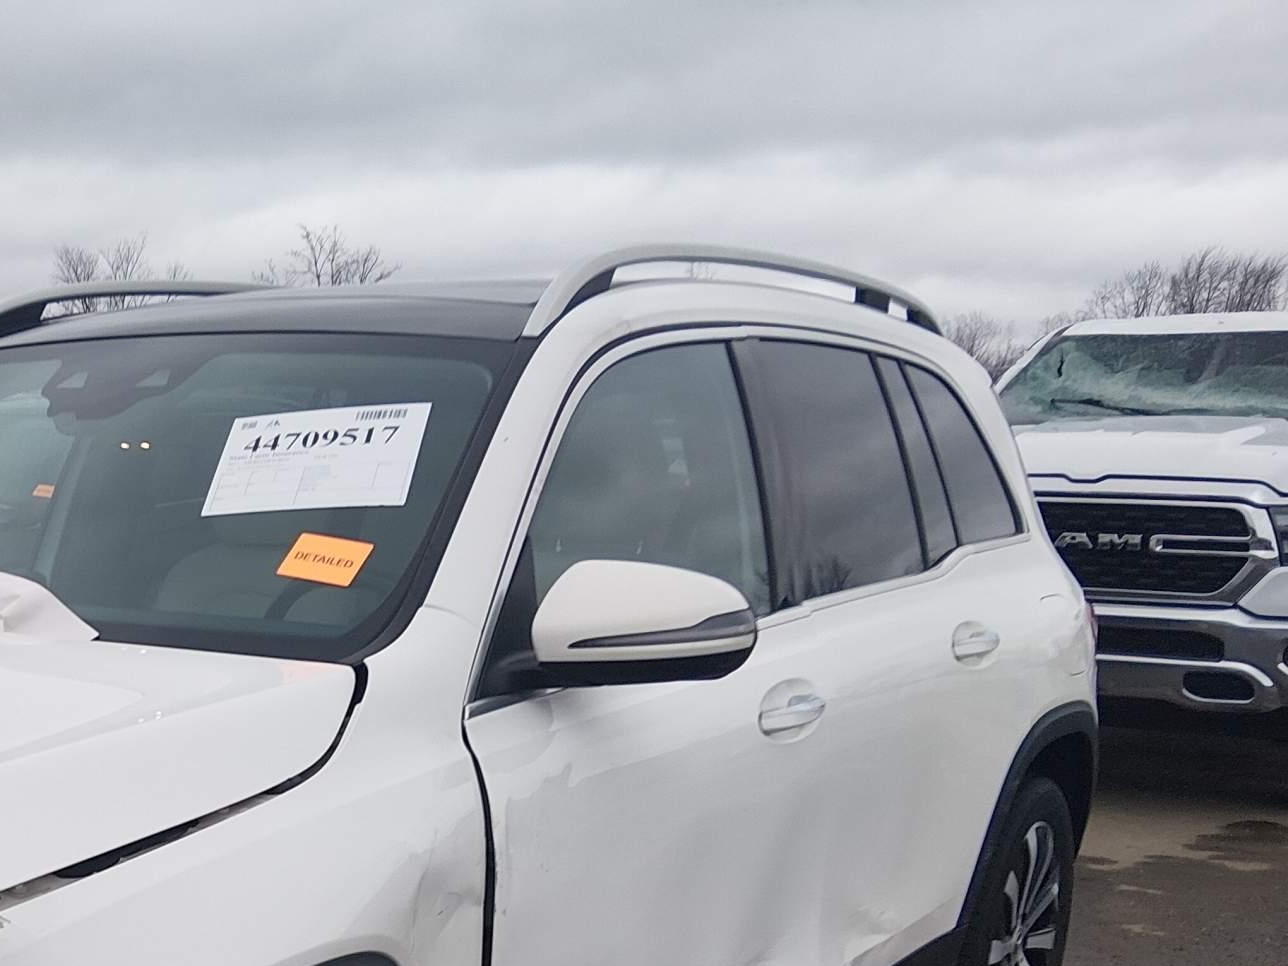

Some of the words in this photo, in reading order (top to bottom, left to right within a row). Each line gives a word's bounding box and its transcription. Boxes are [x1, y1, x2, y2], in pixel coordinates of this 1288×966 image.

[243, 425, 400, 452] 44709517
[1054, 532, 1143, 550] AM
[294, 551, 354, 568] DETAILED
